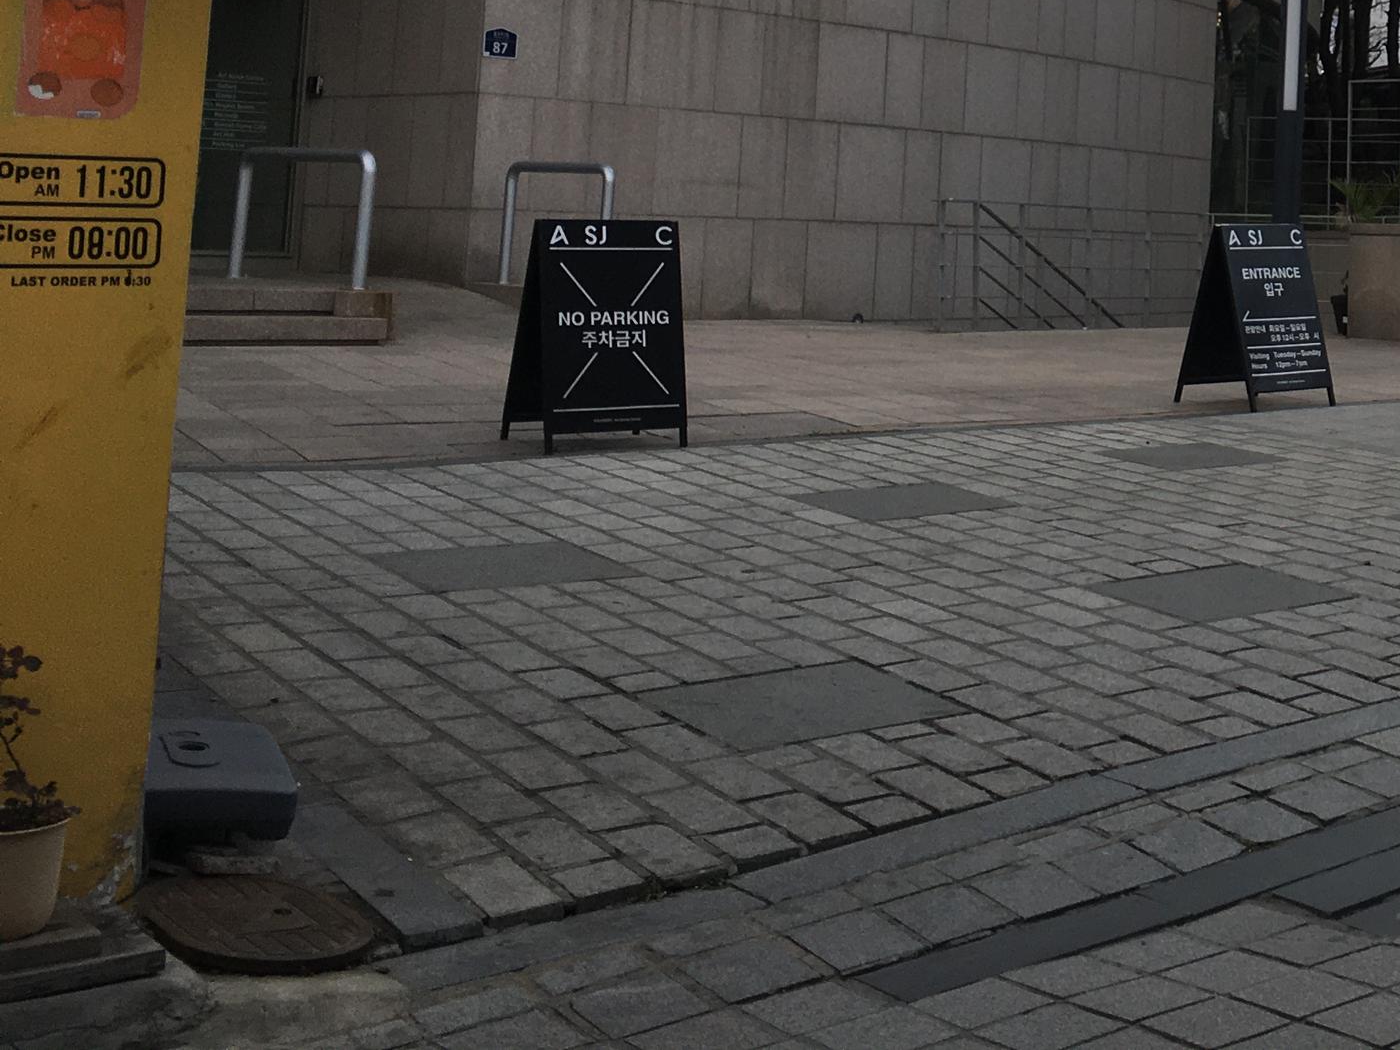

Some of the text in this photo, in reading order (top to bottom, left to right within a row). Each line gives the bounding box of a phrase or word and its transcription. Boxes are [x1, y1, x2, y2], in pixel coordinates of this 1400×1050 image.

[492, 41, 508, 55] 87
[0, 161, 152, 199] Open 11:30
[34, 184, 59, 197] AM
[0, 224, 148, 260] lose 08:00
[550, 225, 673, 246] A SJ C
[1228, 228, 1303, 246] A SJ C
[31, 246, 55, 259] PM
[1241, 266, 1301, 280] ENTRANCE
[11, 276, 46, 287] LAST
[50, 276, 97, 287] ORDER
[101, 276, 120, 287] PM
[1263, 282, 1285, 297] 입구
[558, 310, 670, 327] NO PARKING
[581, 329, 648, 349] 주차금지
